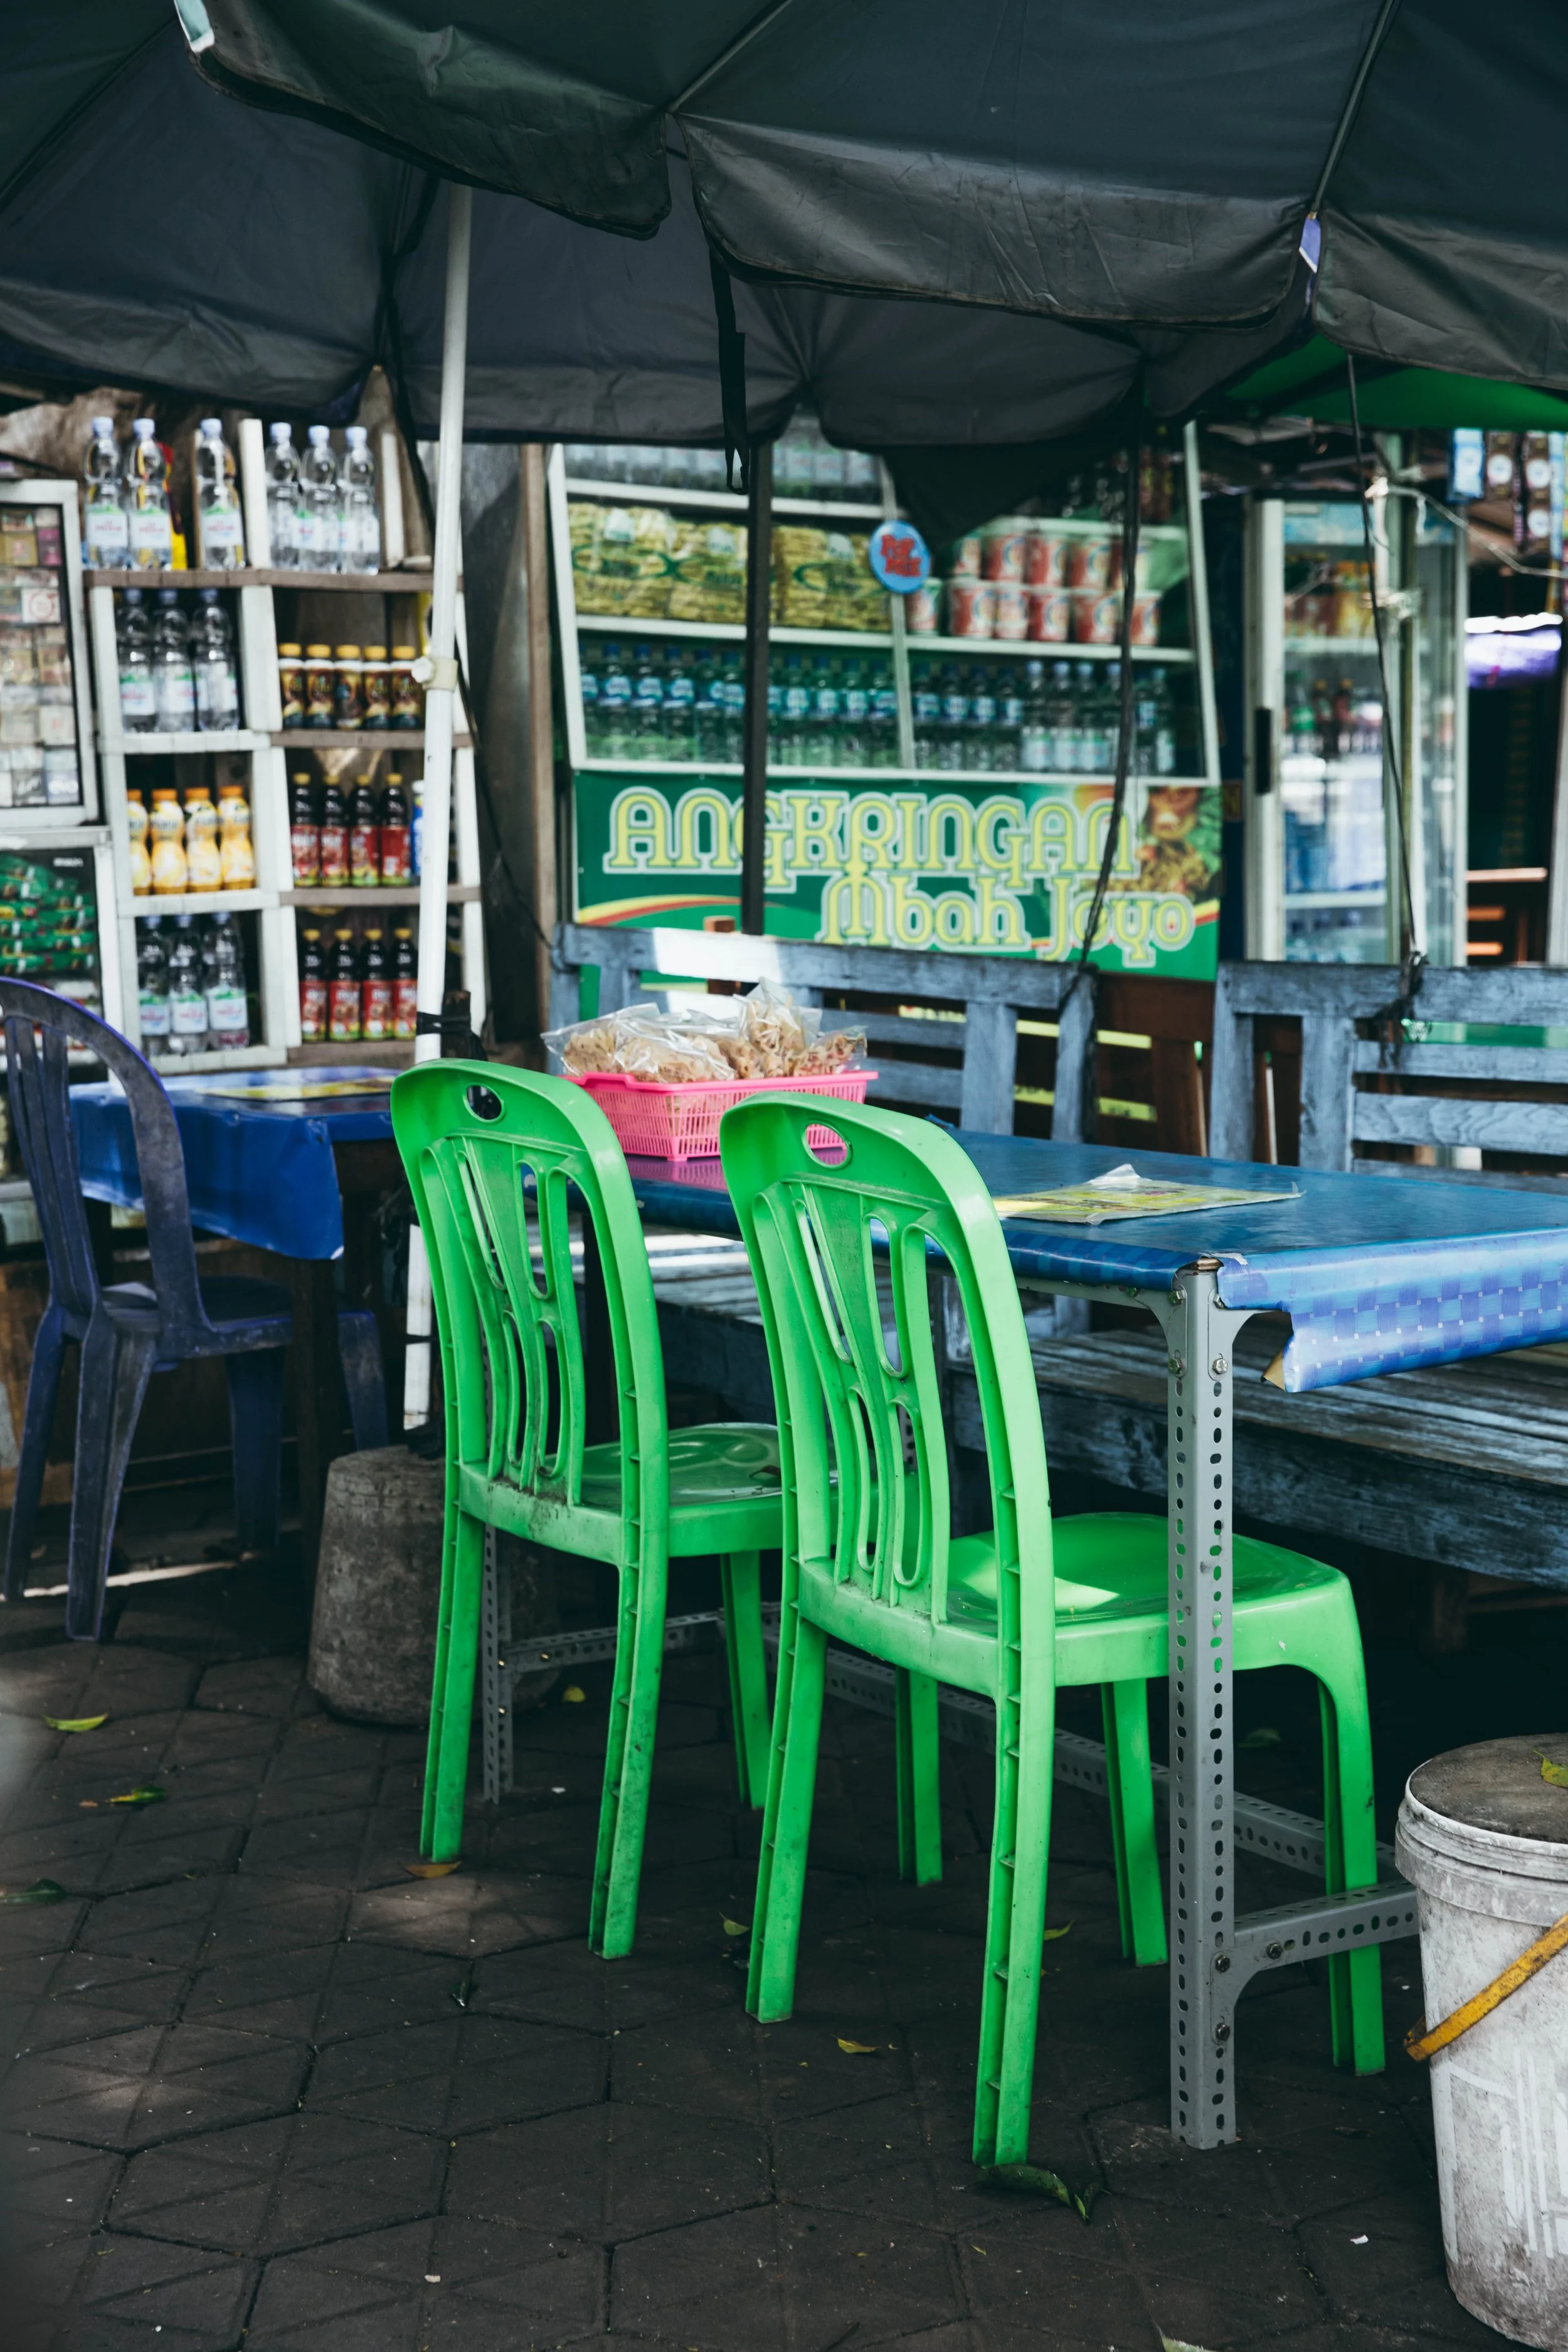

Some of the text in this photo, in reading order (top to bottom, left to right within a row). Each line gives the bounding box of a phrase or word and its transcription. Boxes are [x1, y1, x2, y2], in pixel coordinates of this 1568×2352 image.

[604, 786, 1140, 894] ANGKRINGAN
[817, 863, 1195, 967] Mbah Joyo
